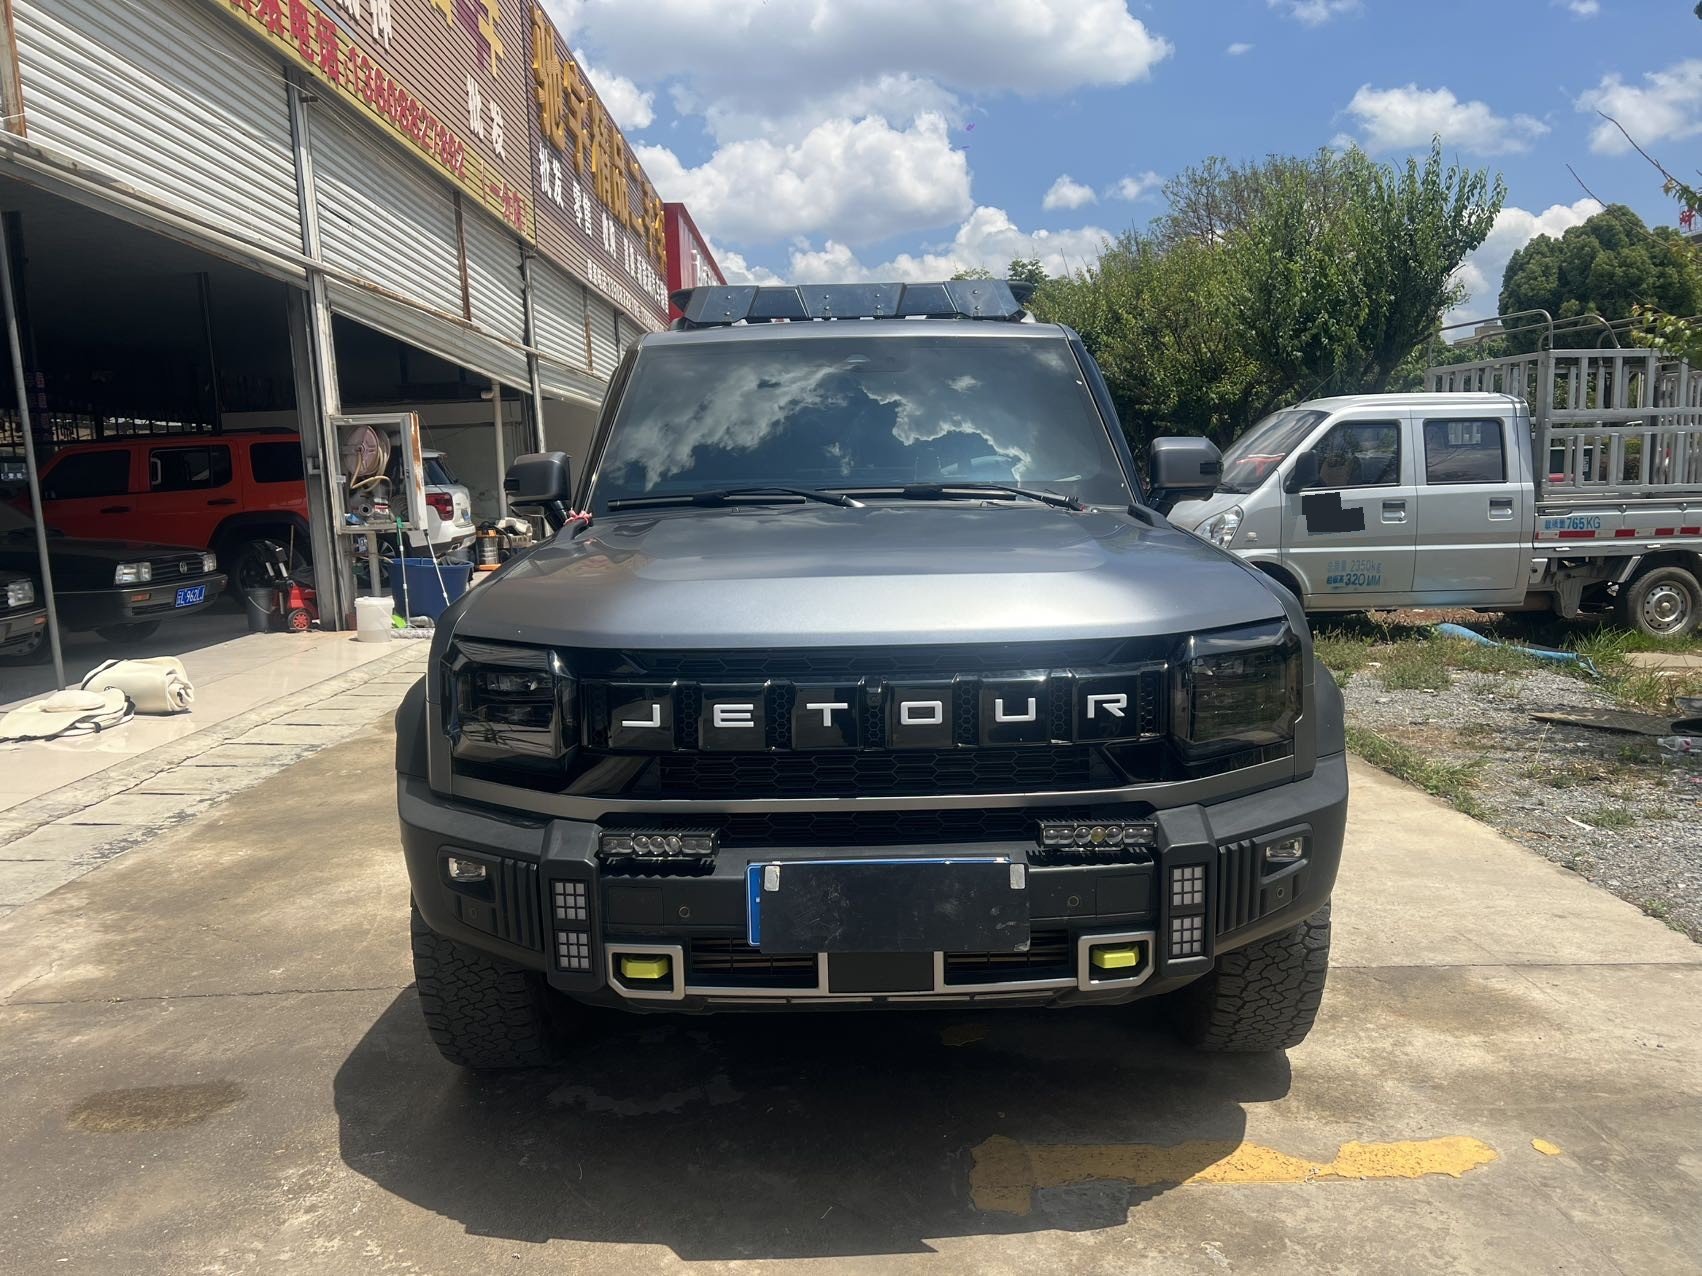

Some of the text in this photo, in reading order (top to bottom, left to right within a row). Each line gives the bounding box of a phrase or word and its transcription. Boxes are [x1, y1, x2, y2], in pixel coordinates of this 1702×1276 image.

[538, 142, 565, 209] 批发
[572, 180, 593, 238] 零售
[1567, 516, 1601, 530] 765KG
[622, 692, 1128, 728] JETOUR
